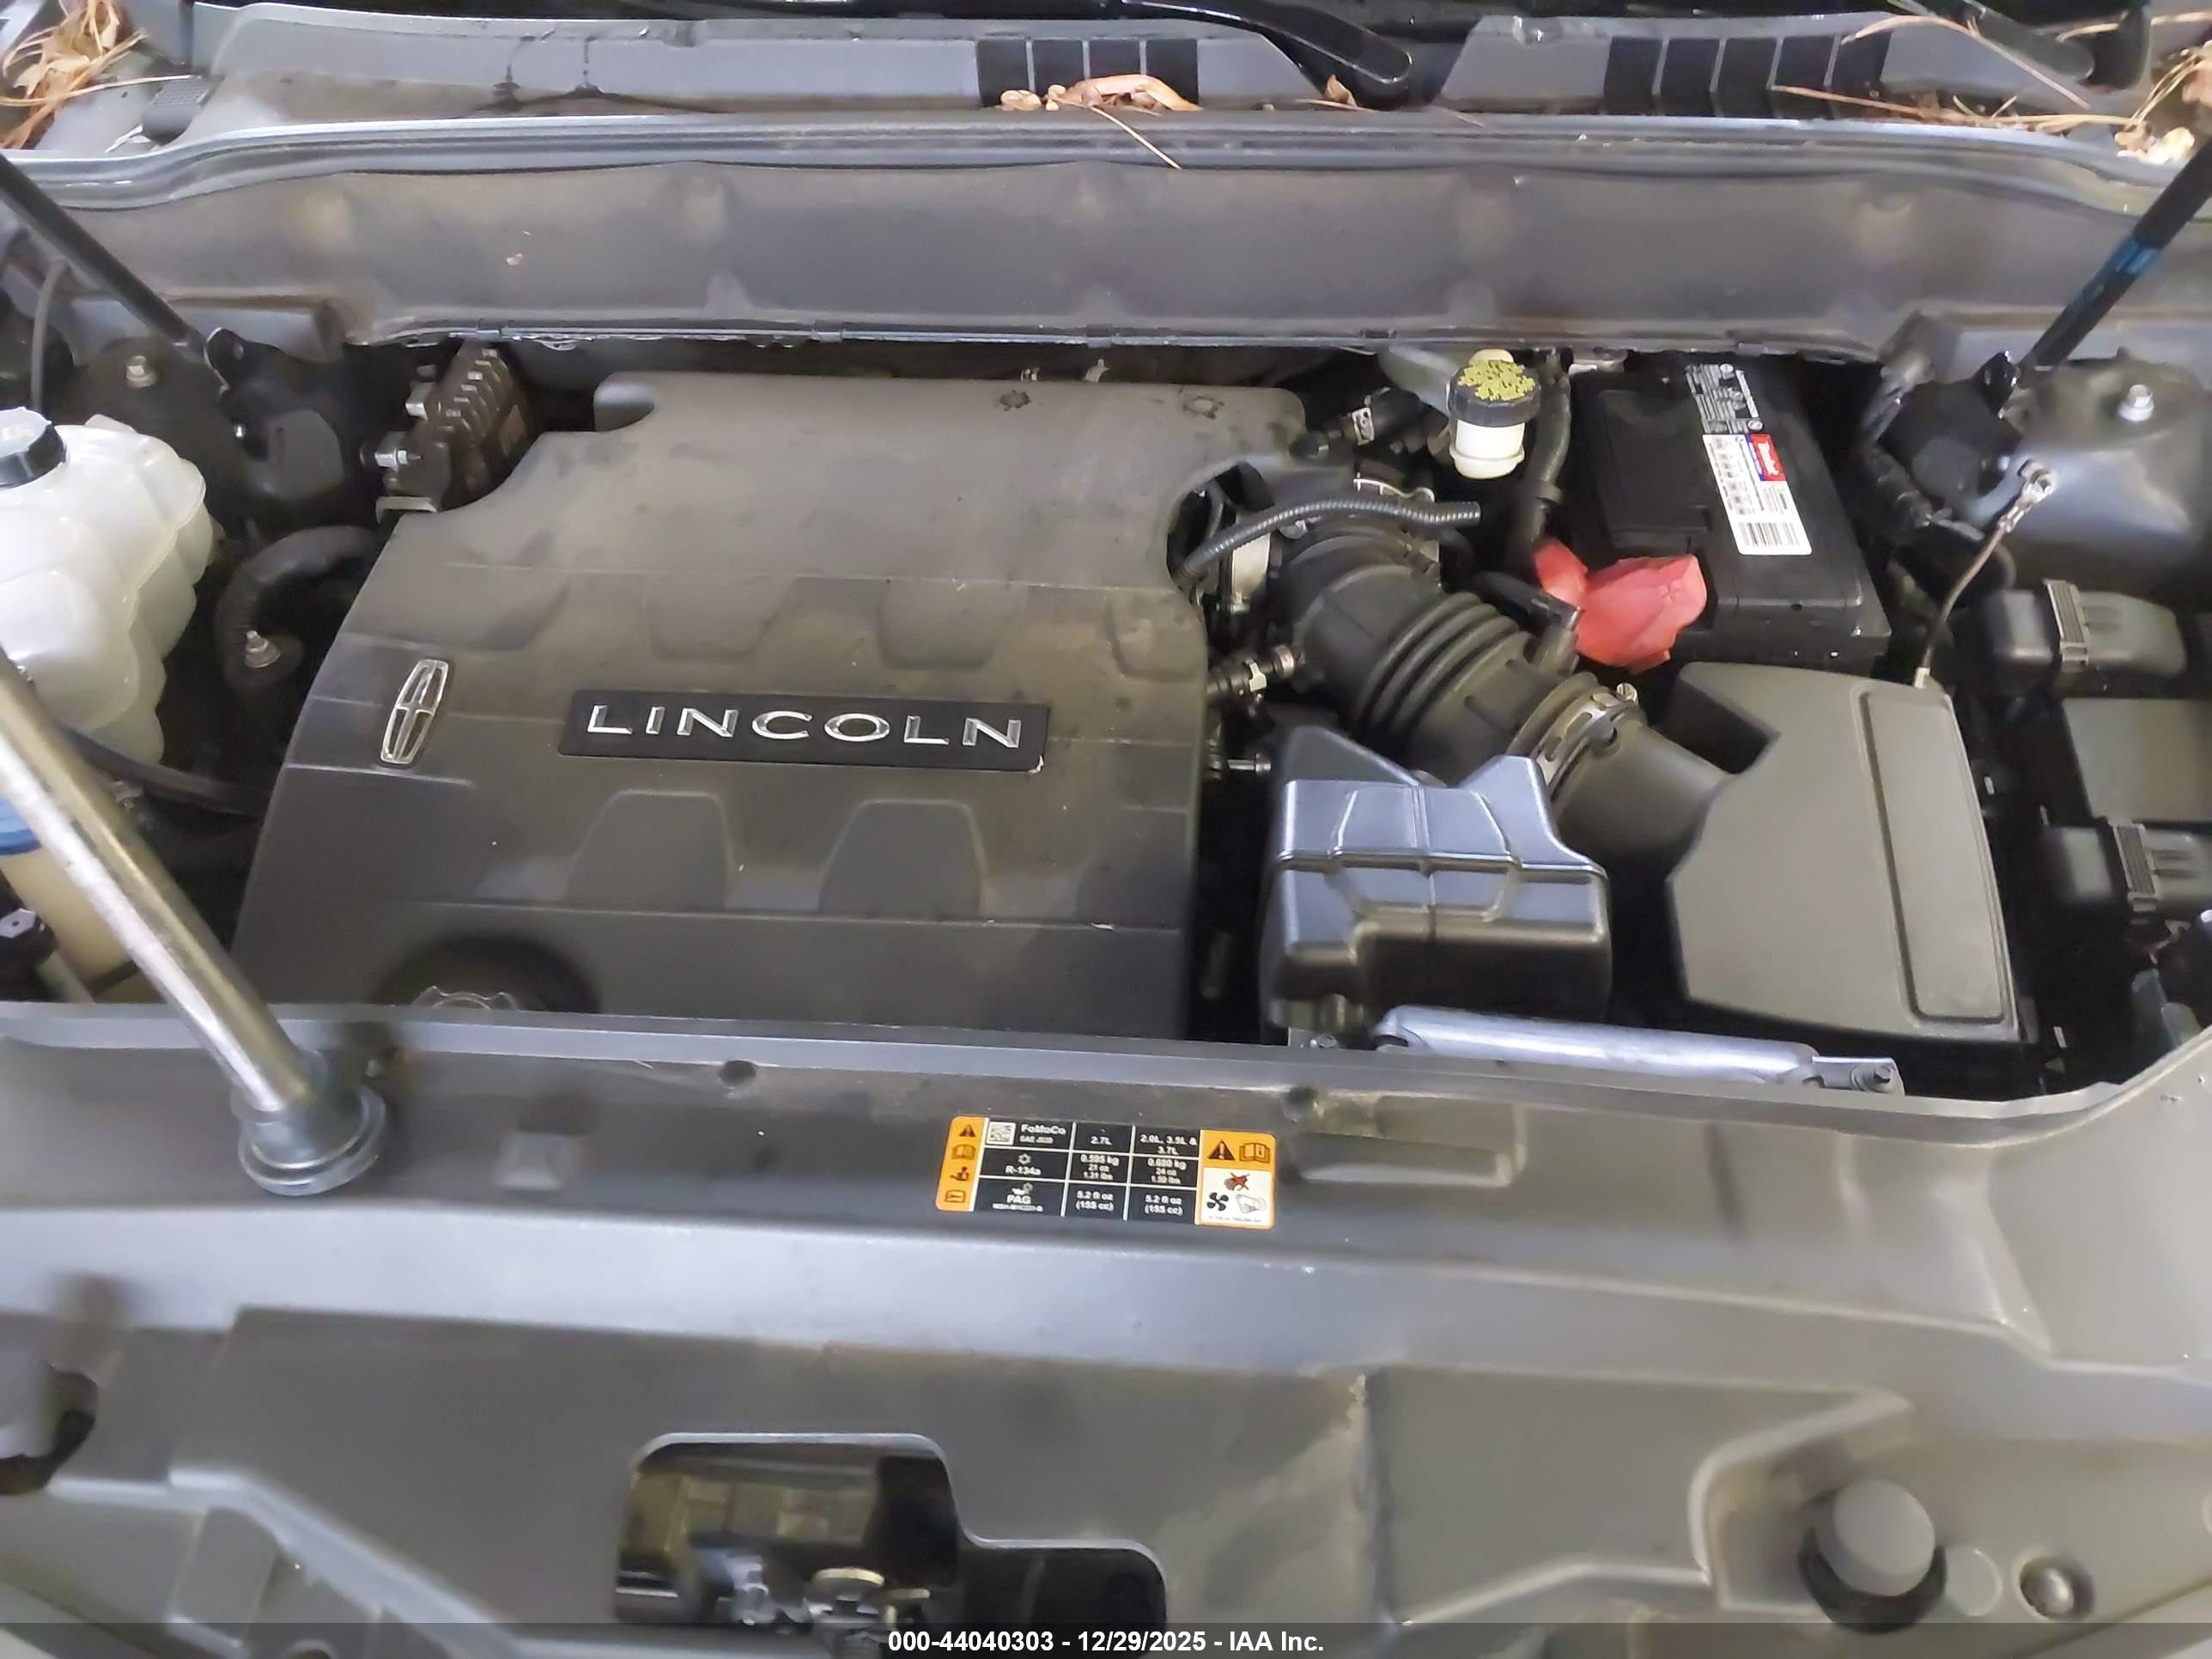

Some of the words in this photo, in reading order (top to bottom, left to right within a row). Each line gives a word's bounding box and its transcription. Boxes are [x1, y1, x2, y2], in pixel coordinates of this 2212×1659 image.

[586, 704, 1022, 749] LINCOLN
[1020, 1123, 1066, 1135] FoMoCo
[1090, 1135, 1113, 1146] 2.7L
[1165, 1135, 1188, 1146] 3.5L
[1188, 1137, 1197, 1146] &
[1157, 1146, 1180, 1156] 3.7L
[1106, 1155, 1120, 1167] kg
[1174, 1159, 1188, 1171] kg
[1005, 1164, 1042, 1176] R-134a
[1006, 1194, 1031, 1205] PAG
[1076, 1190, 1091, 1200] 5.2
[1145, 1194, 1160, 1203] 5.2
[1170, 1197, 1182, 1206] oz
